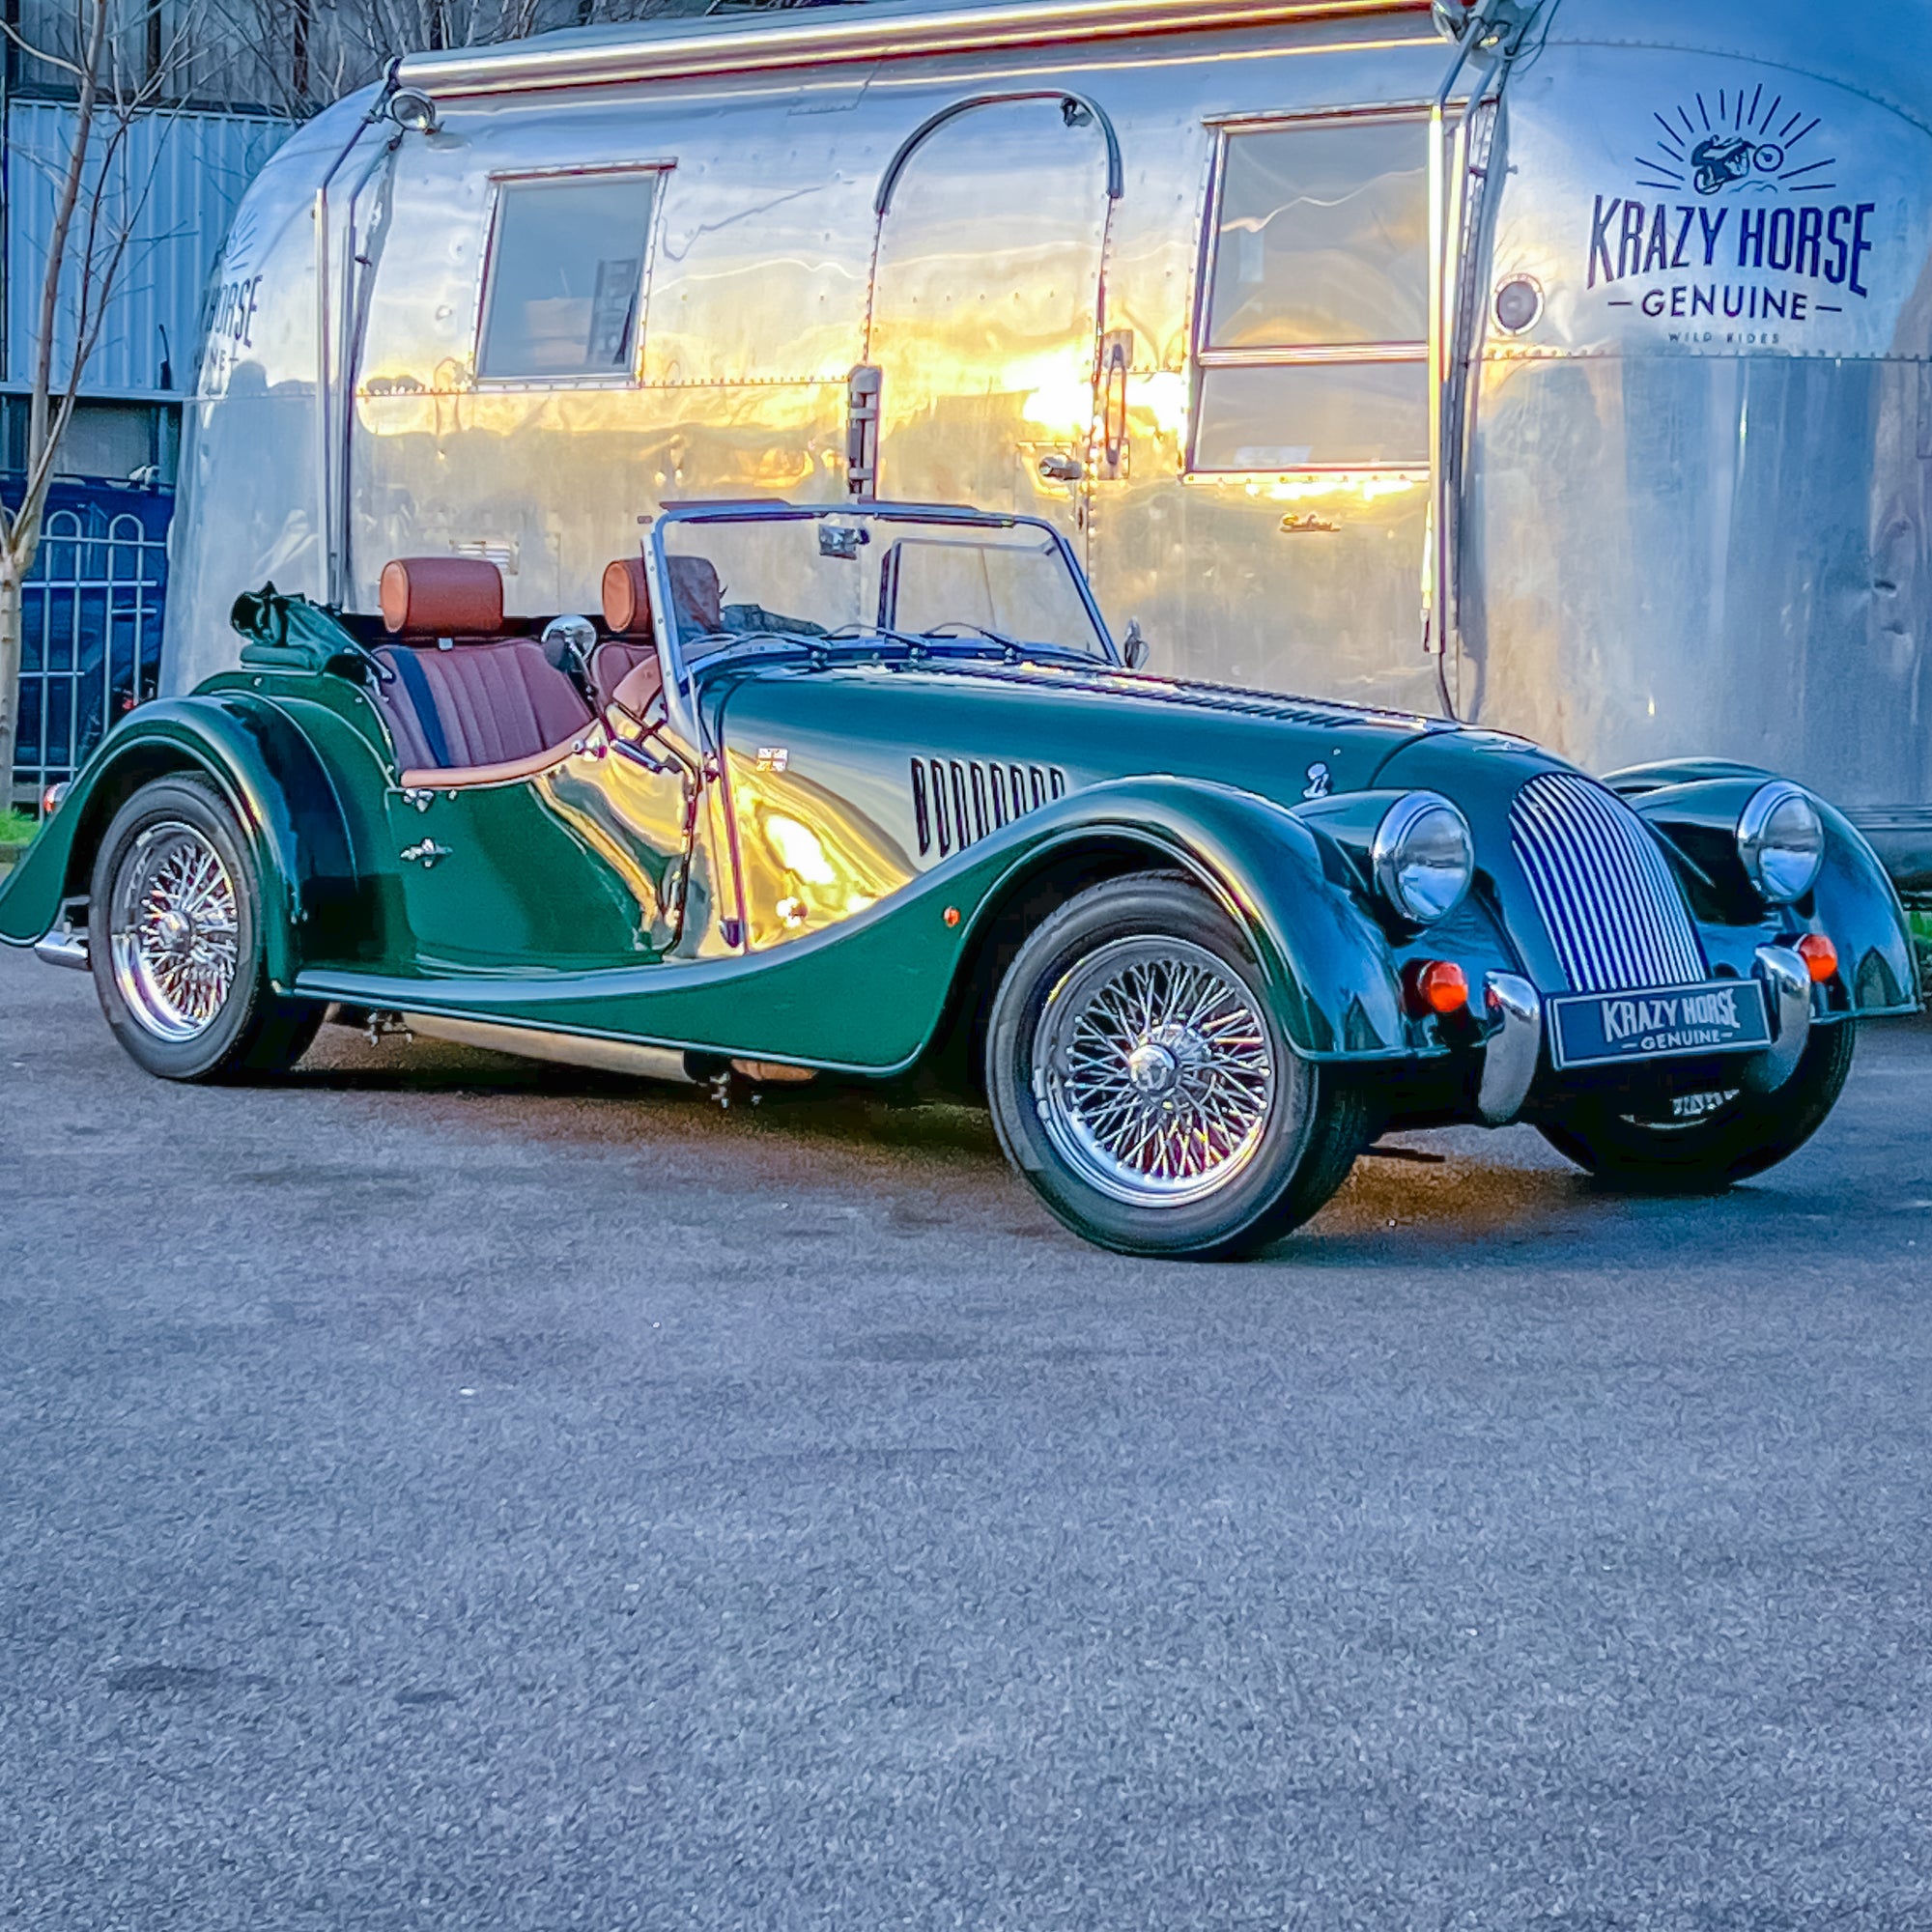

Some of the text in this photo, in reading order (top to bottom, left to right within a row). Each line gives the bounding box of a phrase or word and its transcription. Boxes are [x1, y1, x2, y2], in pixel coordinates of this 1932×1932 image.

[1587, 194, 1875, 298] KRAZY HORSE
[1641, 284, 1807, 321] GENUINE
[1668, 331, 1780, 344] WILD RIDES
[1601, 987, 1741, 1042] KRAZY HORSE
[1640, 1030, 1720, 1051] GENUINE
